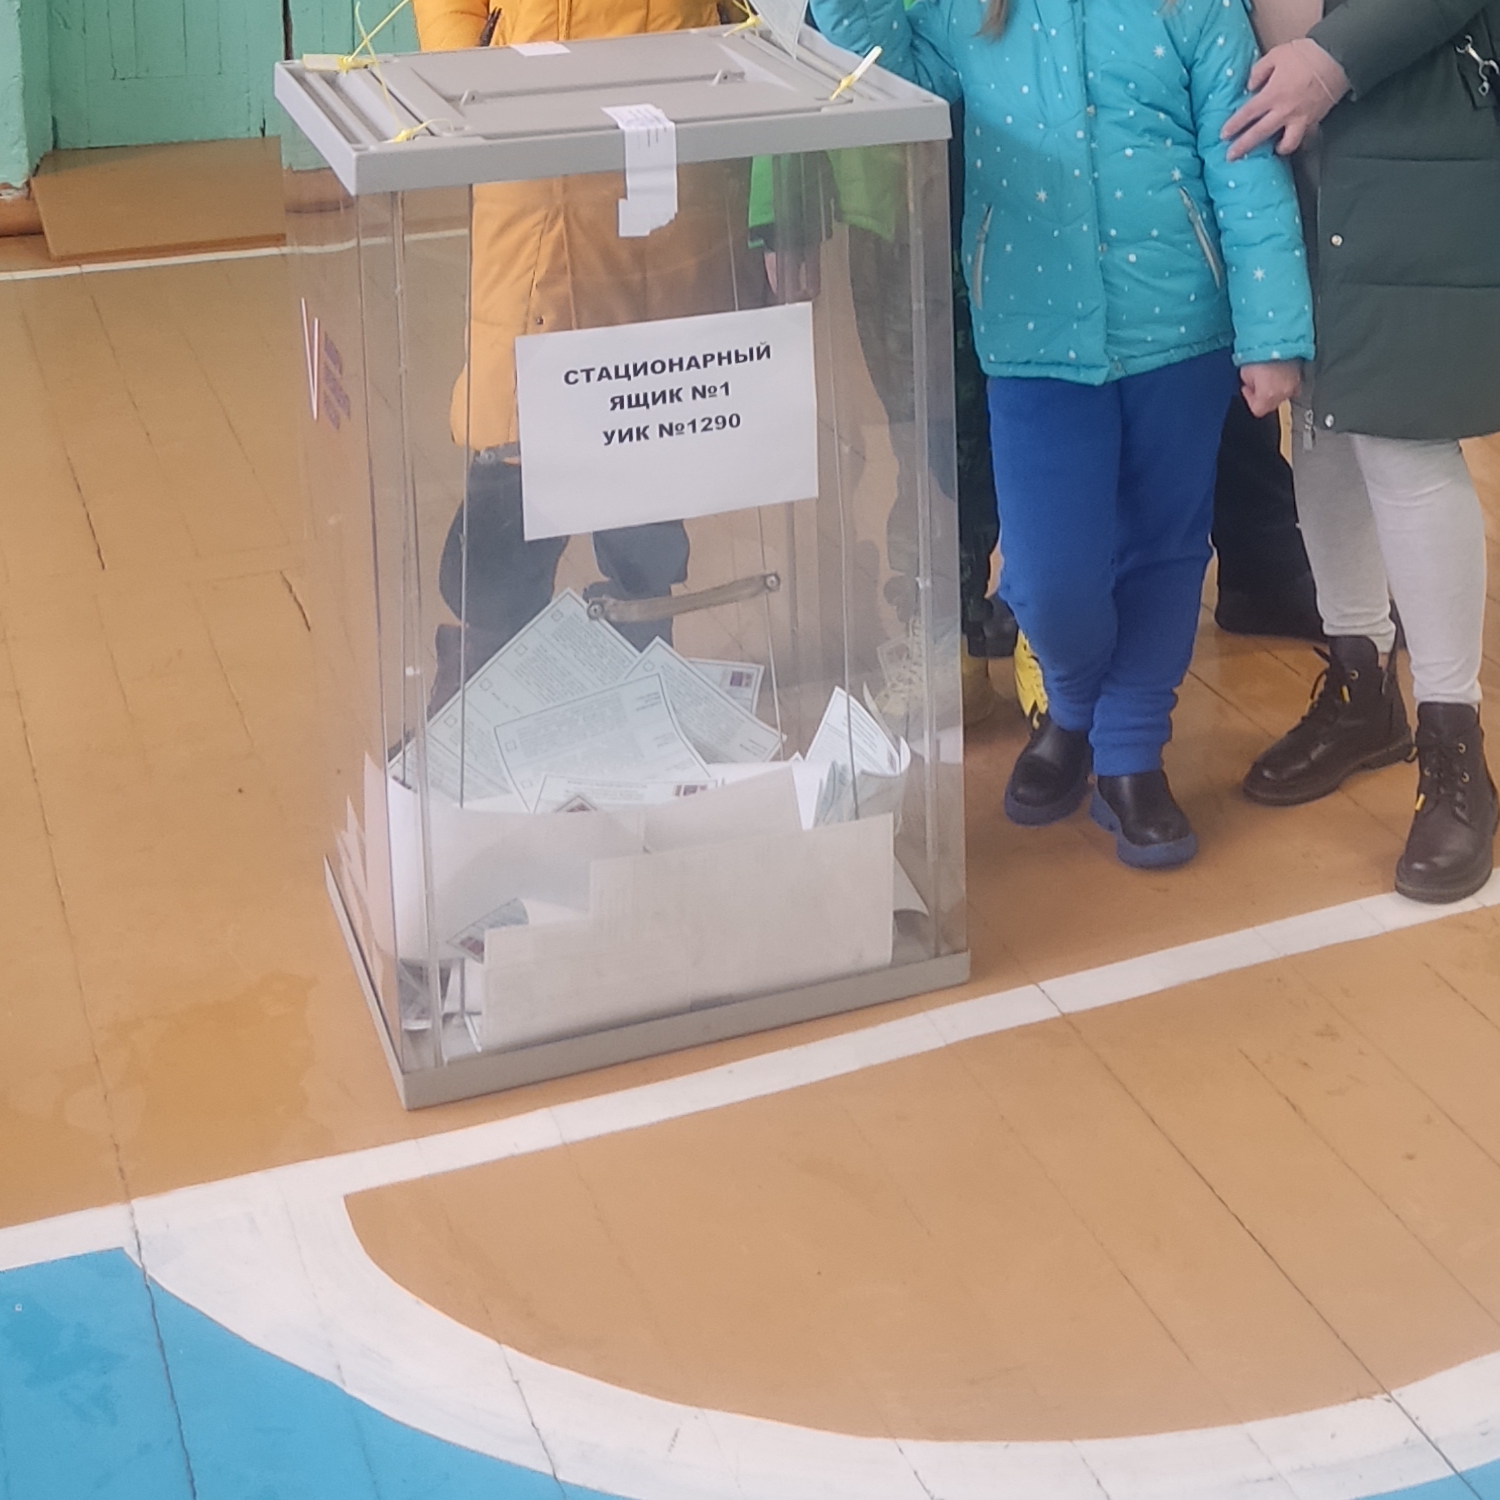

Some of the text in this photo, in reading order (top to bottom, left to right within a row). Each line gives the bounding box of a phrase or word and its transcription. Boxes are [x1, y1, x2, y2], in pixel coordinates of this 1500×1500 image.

[564, 342, 772, 385] СТАЦИОНАРНЫЙ
[609, 381, 731, 411] ЯЩИК №1
[603, 413, 742, 446] УИК №1290
